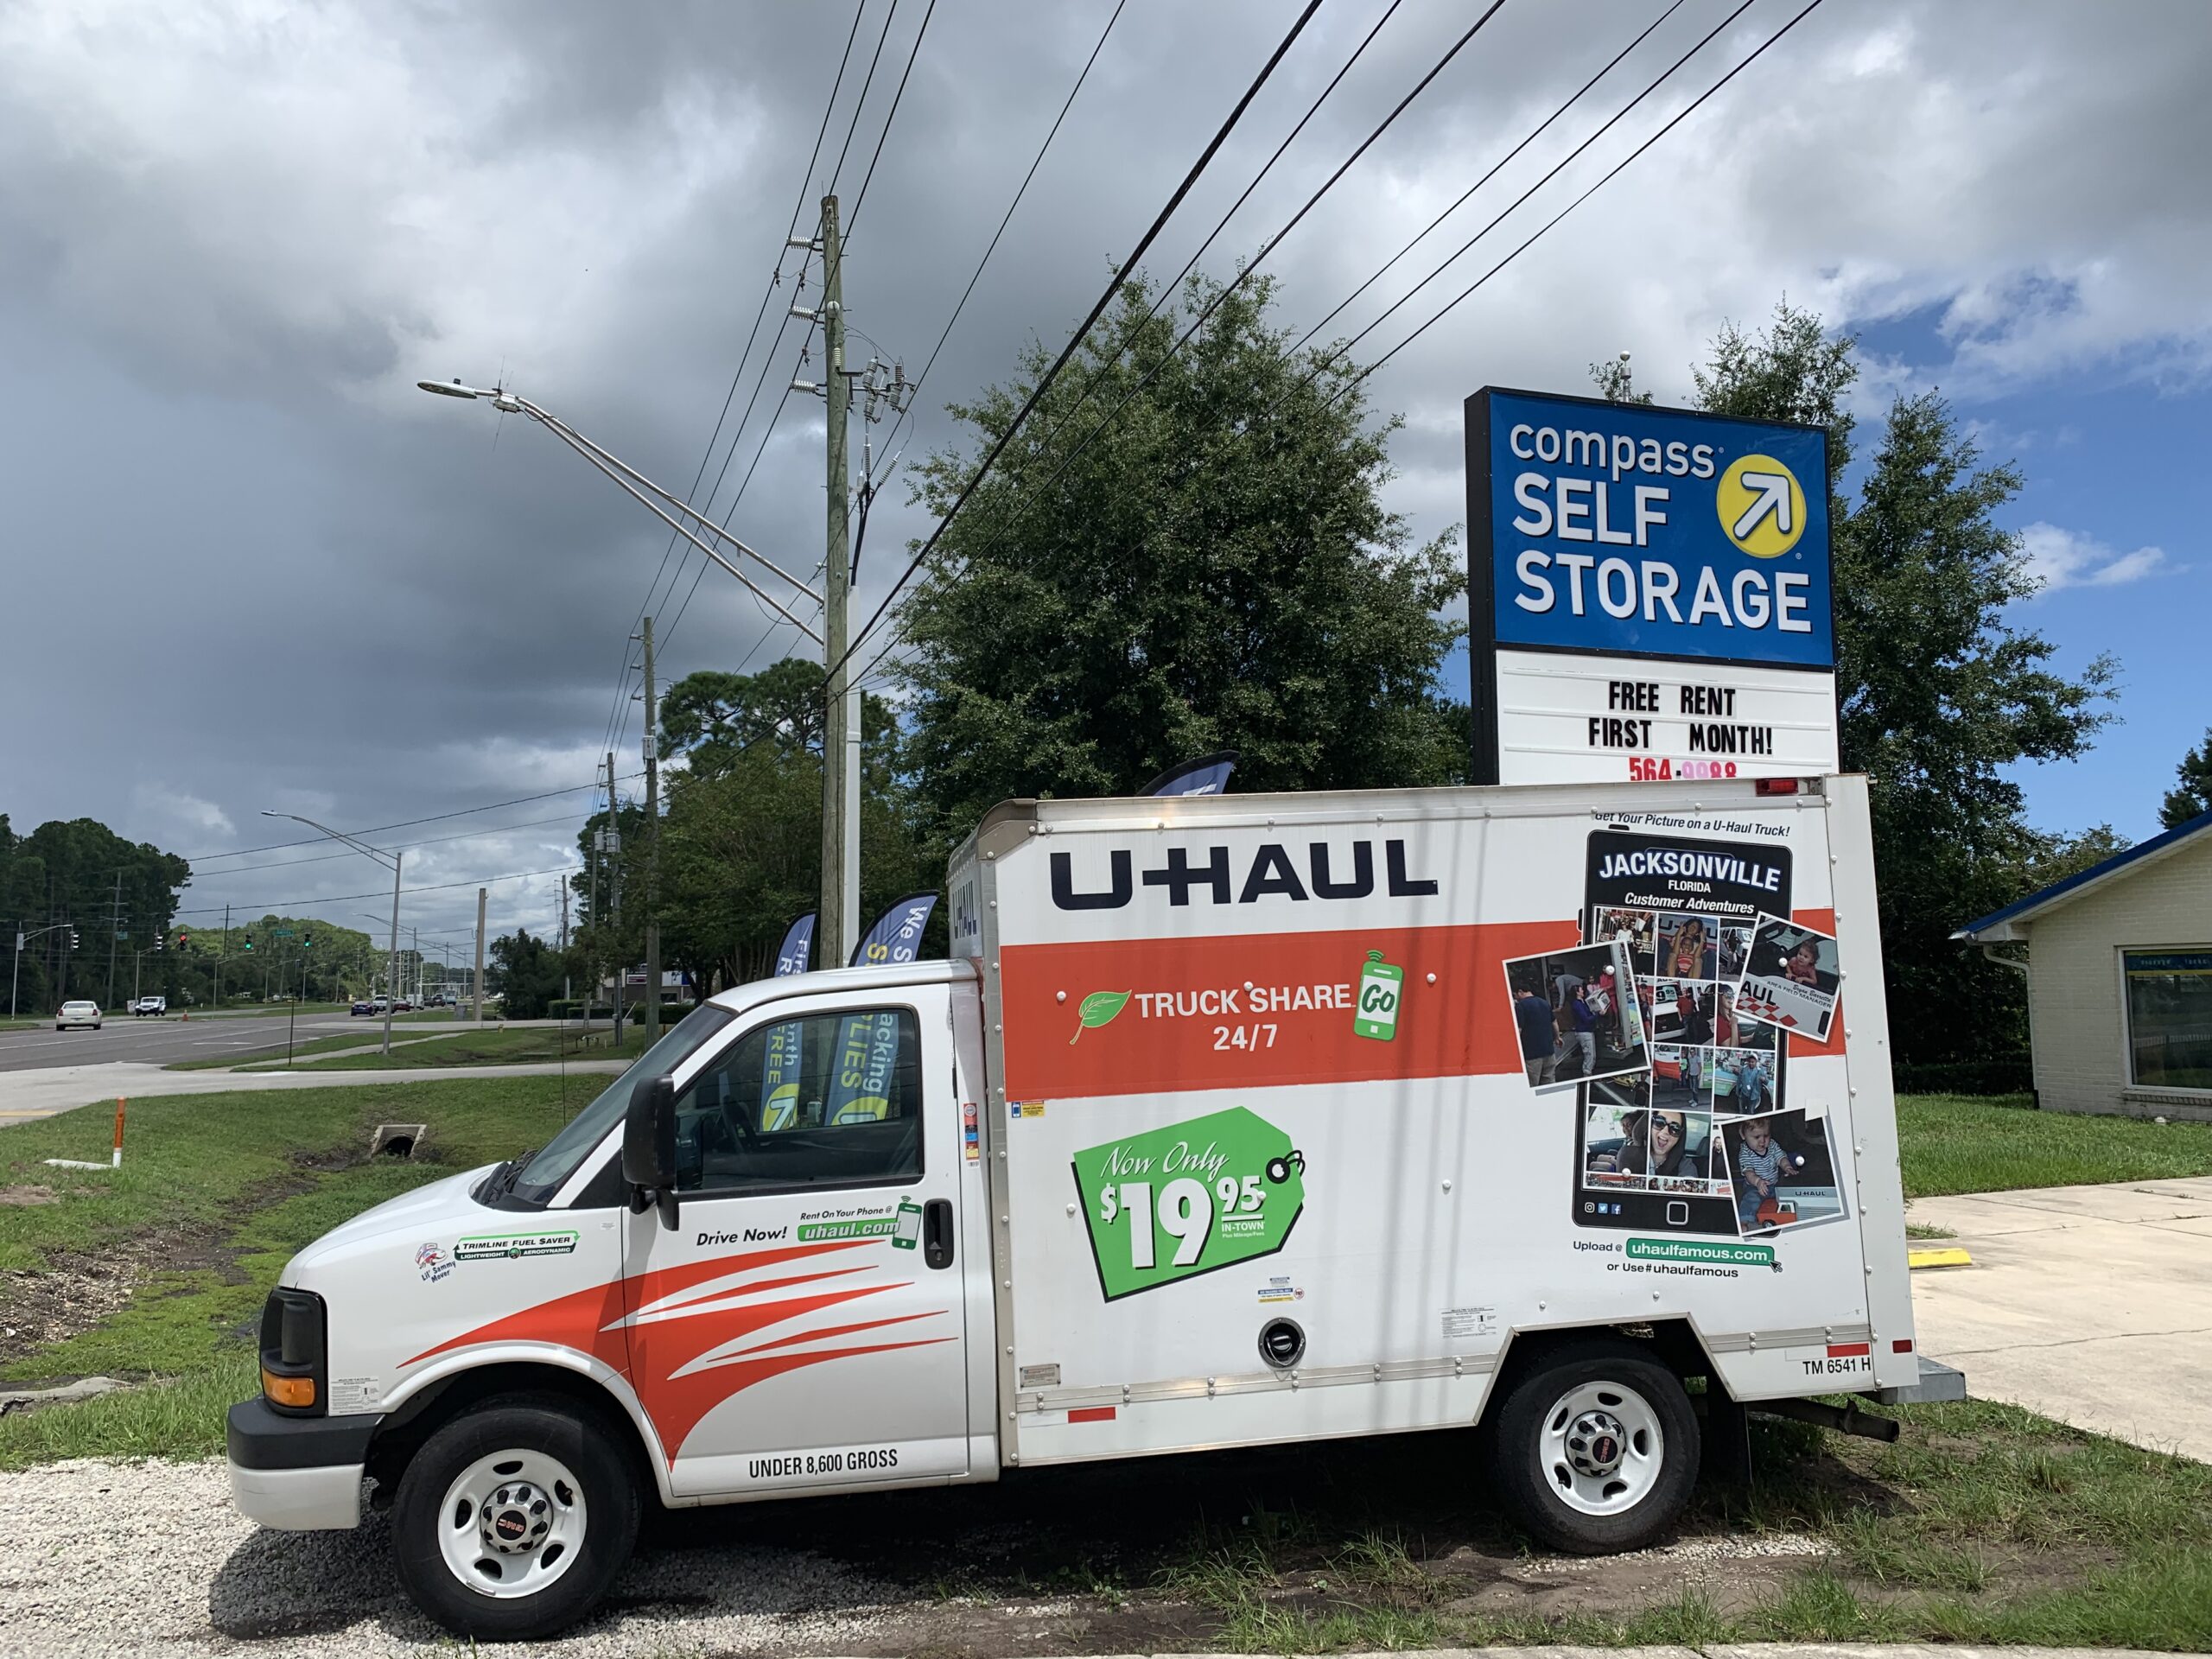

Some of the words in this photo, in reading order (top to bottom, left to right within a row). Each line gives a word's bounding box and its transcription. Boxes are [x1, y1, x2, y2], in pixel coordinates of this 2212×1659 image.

[1510, 423, 1714, 482] compass
[1512, 472, 1670, 546] SELF
[1514, 550, 1812, 633] STORAGE
[1609, 681, 1659, 712] FREE
[1681, 685, 1736, 715] RENT
[1588, 718, 1652, 748] FIRST
[1689, 723, 1772, 754] MONTH!
[1618, 812, 1643, 824] Your
[1644, 814, 1685, 829] Picture
[1687, 820, 1701, 829] on
[1703, 822, 1710, 830] a
[1713, 820, 1752, 834] U-Haul
[1755, 823, 1790, 836] Truck!
[1050, 839, 1439, 911] U-HAUL
[1600, 852, 1779, 891] JACKSONVILLE
[1668, 879, 1711, 893] FLORIDA
[1624, 892, 1684, 911] Customer
[1686, 897, 1755, 915] Adventures
[899, 906, 928, 939] We
[792, 939, 808, 975] Firs
[1135, 989, 1239, 1018] TRUCK
[1249, 983, 1352, 1012] SHARE
[1213, 1023, 1279, 1052] 24/7
[862, 1014, 893, 1093] acking
[1100, 1146, 1158, 1178] Now
[1162, 1141, 1230, 1182] Only
[800, 1211, 820, 1220] Rent
[836, 1209, 855, 1217] Your
[856, 1207, 884, 1216] Phone
[1222, 1221, 1264, 1232] IN-TOWN
[696, 1232, 738, 1246] Drive
[743, 1226, 788, 1243] Now!
[804, 1220, 900, 1240] uhaul.com
[461, 1251, 505, 1260] LIGHTWEIGHT
[523, 1247, 571, 1255] AERODYNAMIC
[463, 1241, 508, 1250] TRIMLINE
[1573, 1240, 1612, 1252] Upload
[1615, 1243, 1623, 1252] @
[1631, 1242, 1768, 1262] uhaulfamous.com
[432, 1261, 456, 1274] Sammy
[1606, 1262, 1619, 1271] or
[1803, 1361, 1823, 1375] TM
[1827, 1359, 1857, 1374] 6541
[1861, 1357, 1871, 1371] H
[749, 1457, 802, 1478] UNDER
[806, 1454, 842, 1476] 8,600
[847, 1449, 898, 1471] GROSS
